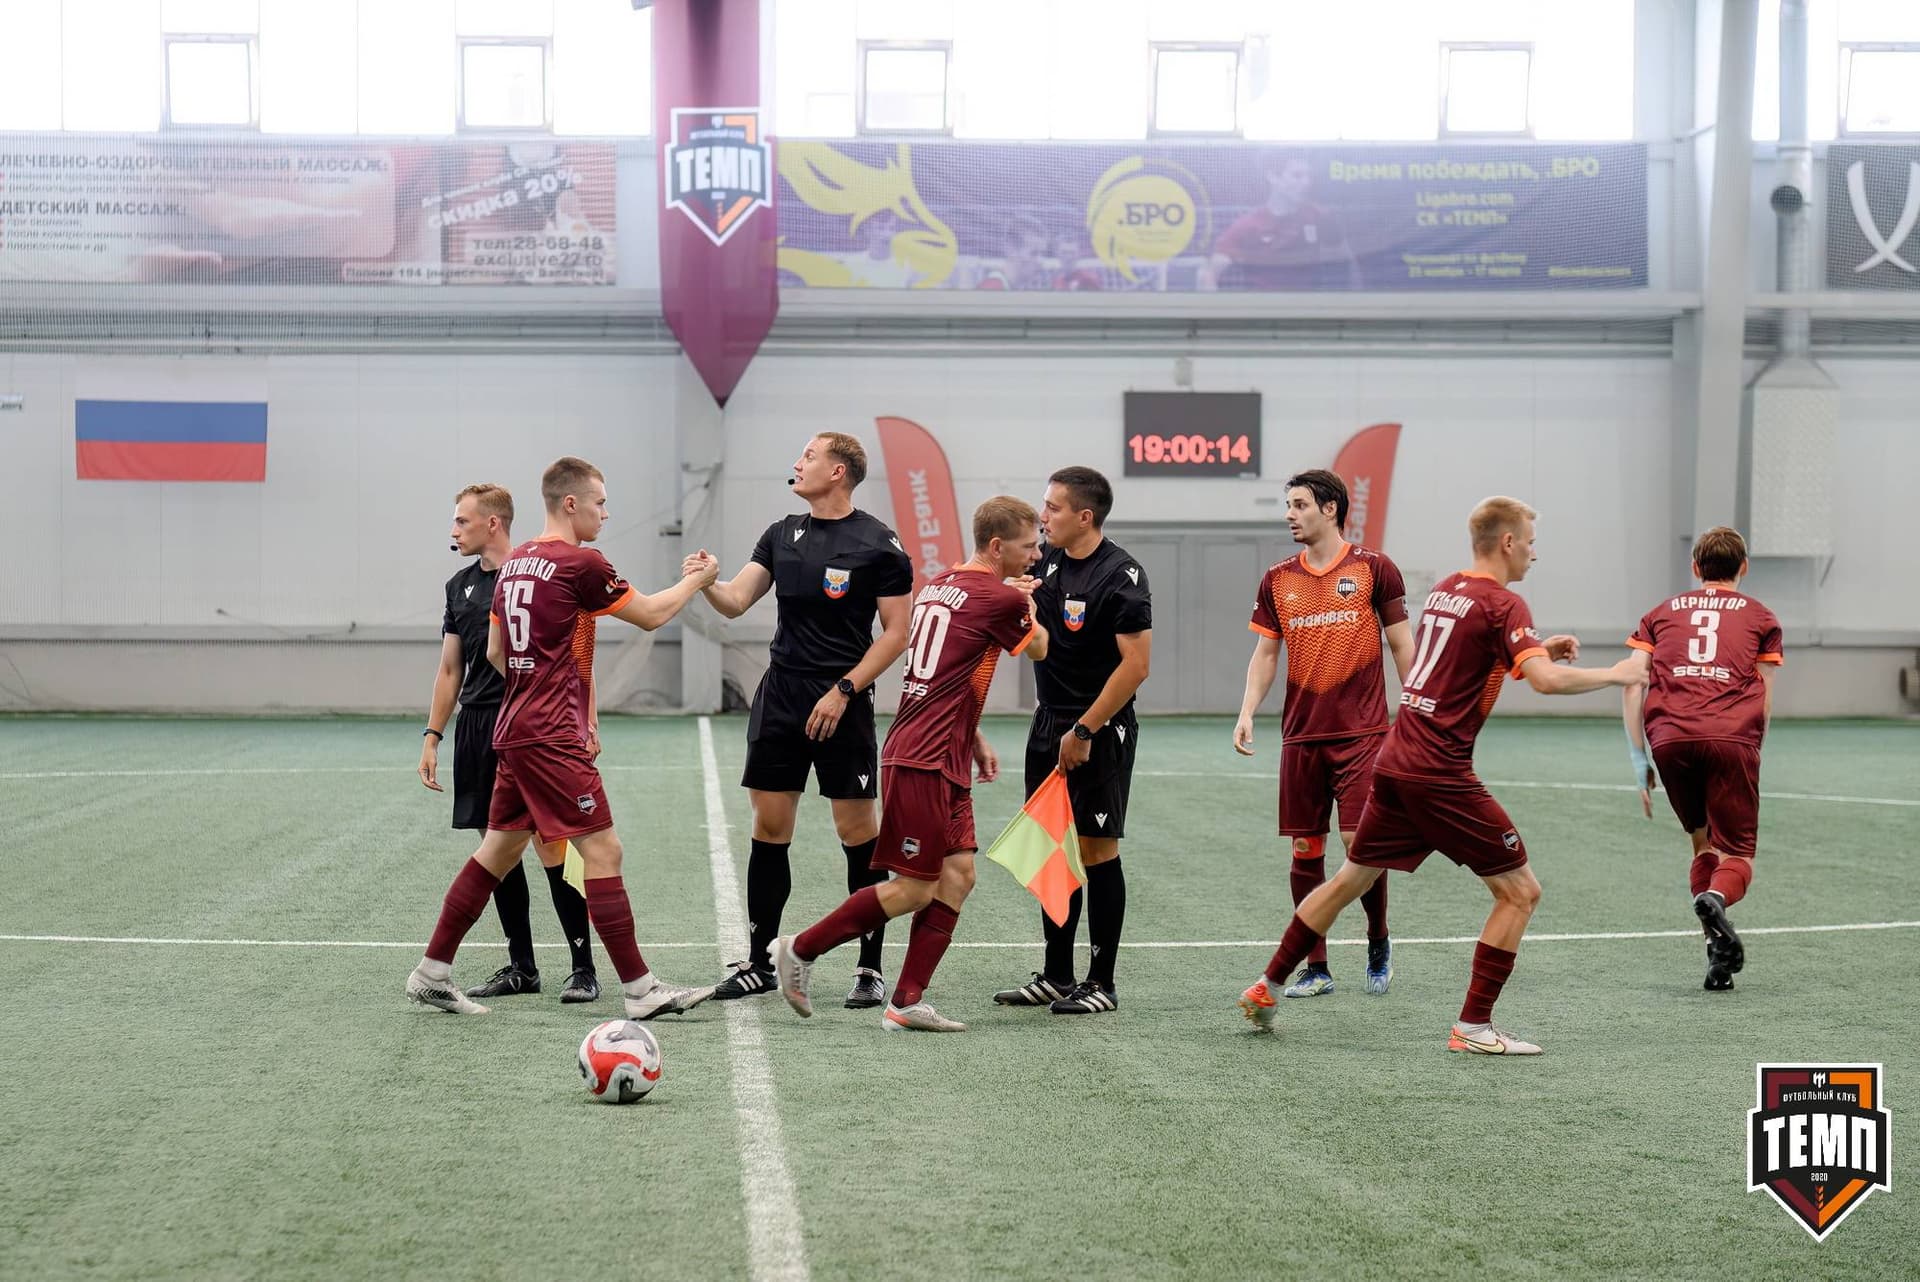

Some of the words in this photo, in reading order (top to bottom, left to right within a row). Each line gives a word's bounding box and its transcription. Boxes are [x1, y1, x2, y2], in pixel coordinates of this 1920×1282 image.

[675, 145, 762, 194] ТЕМП
[1330, 160, 1401, 182] Время
[524, 165, 584, 200] 20%
[0, 198, 90, 216] ДЕТСКИЙ
[96, 202, 188, 217] МАССАЖ:
[1129, 434, 1251, 464] 19:00:14
[498, 555, 558, 583] ТУШЕНКО
[502, 580, 536, 652] 15
[1671, 596, 1748, 611] ВЕРНИГОР
[1688, 609, 1721, 664] 3
[508, 656, 536, 670] EUS
[1403, 613, 1457, 691] 17
[1672, 665, 1731, 680] SEUS
[902, 680, 929, 697] EUS
[1400, 692, 1437, 714] EUS
